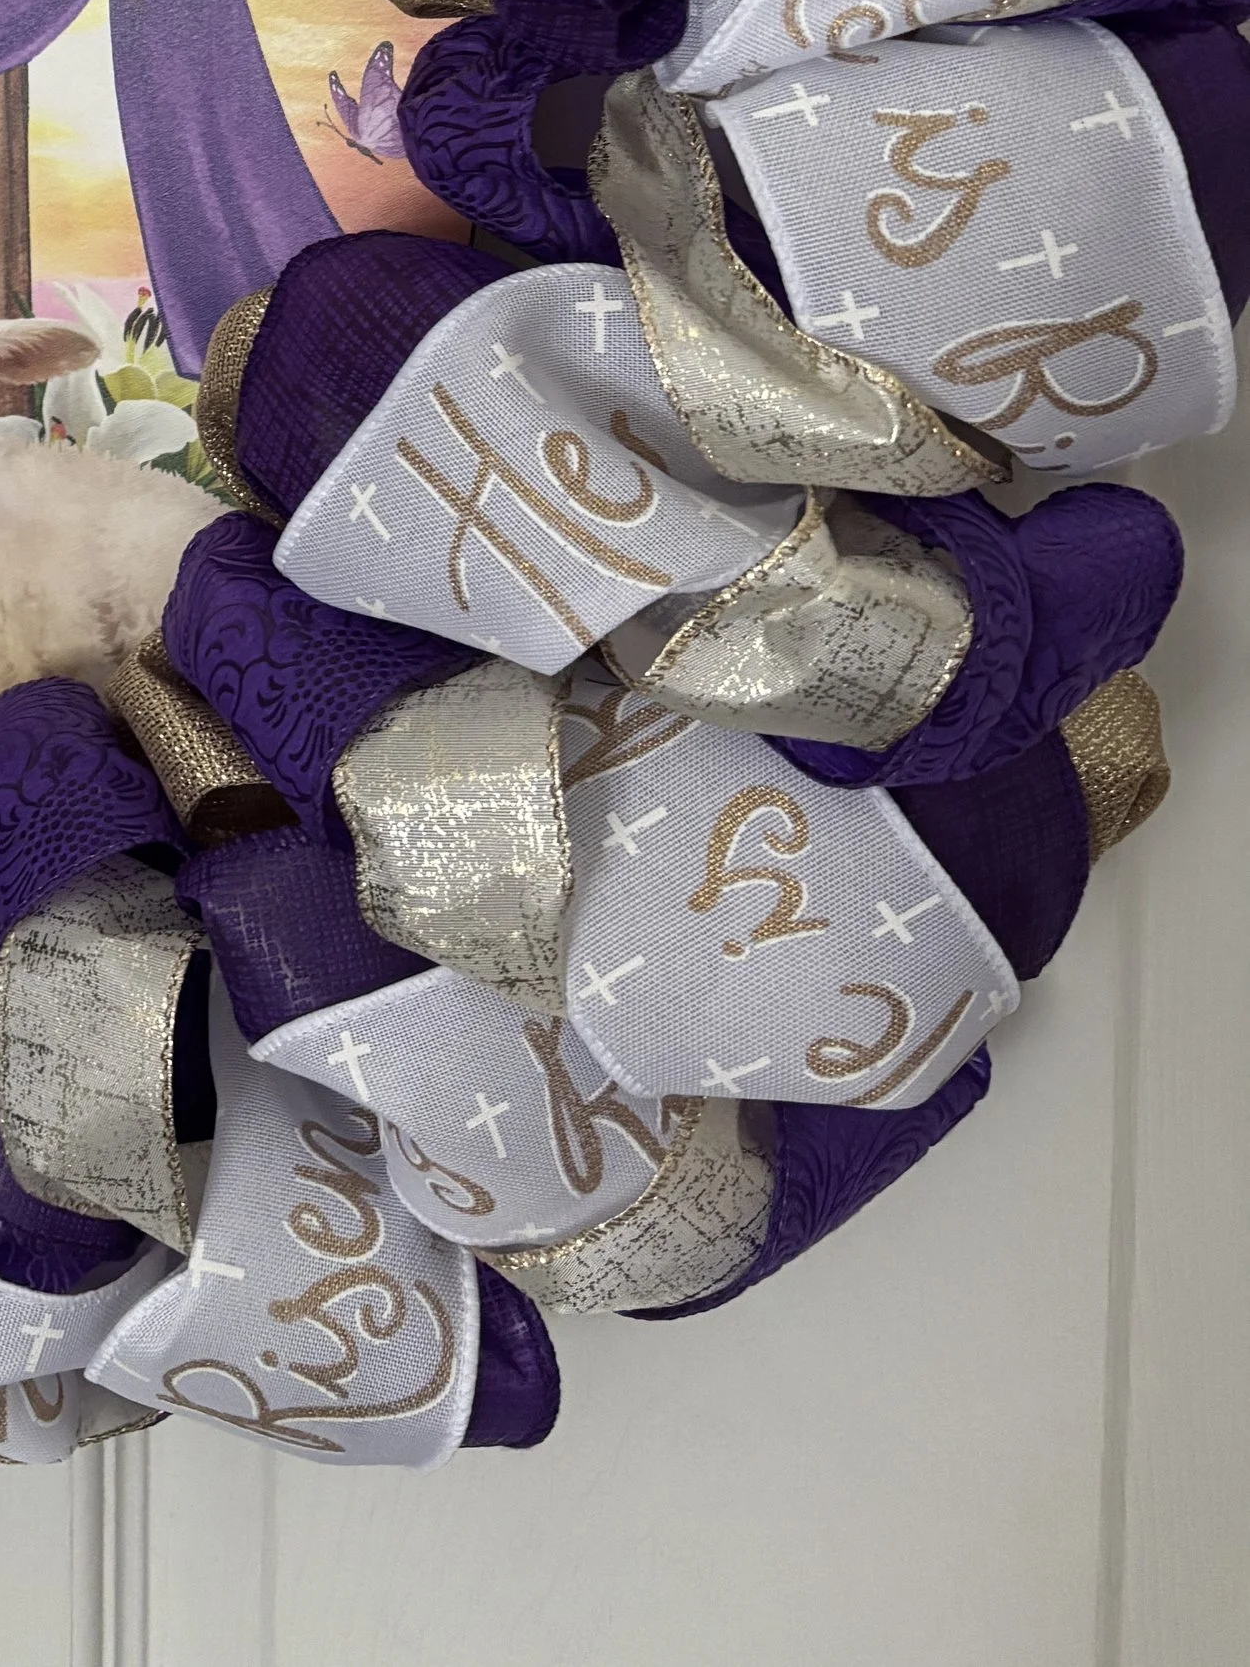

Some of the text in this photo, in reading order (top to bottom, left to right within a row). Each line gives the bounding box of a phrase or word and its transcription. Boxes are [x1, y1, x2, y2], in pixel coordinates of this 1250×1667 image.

[867, 105, 1012, 268] is
[395, 379, 674, 650] He
[155, 1106, 455, 1453] Risen
